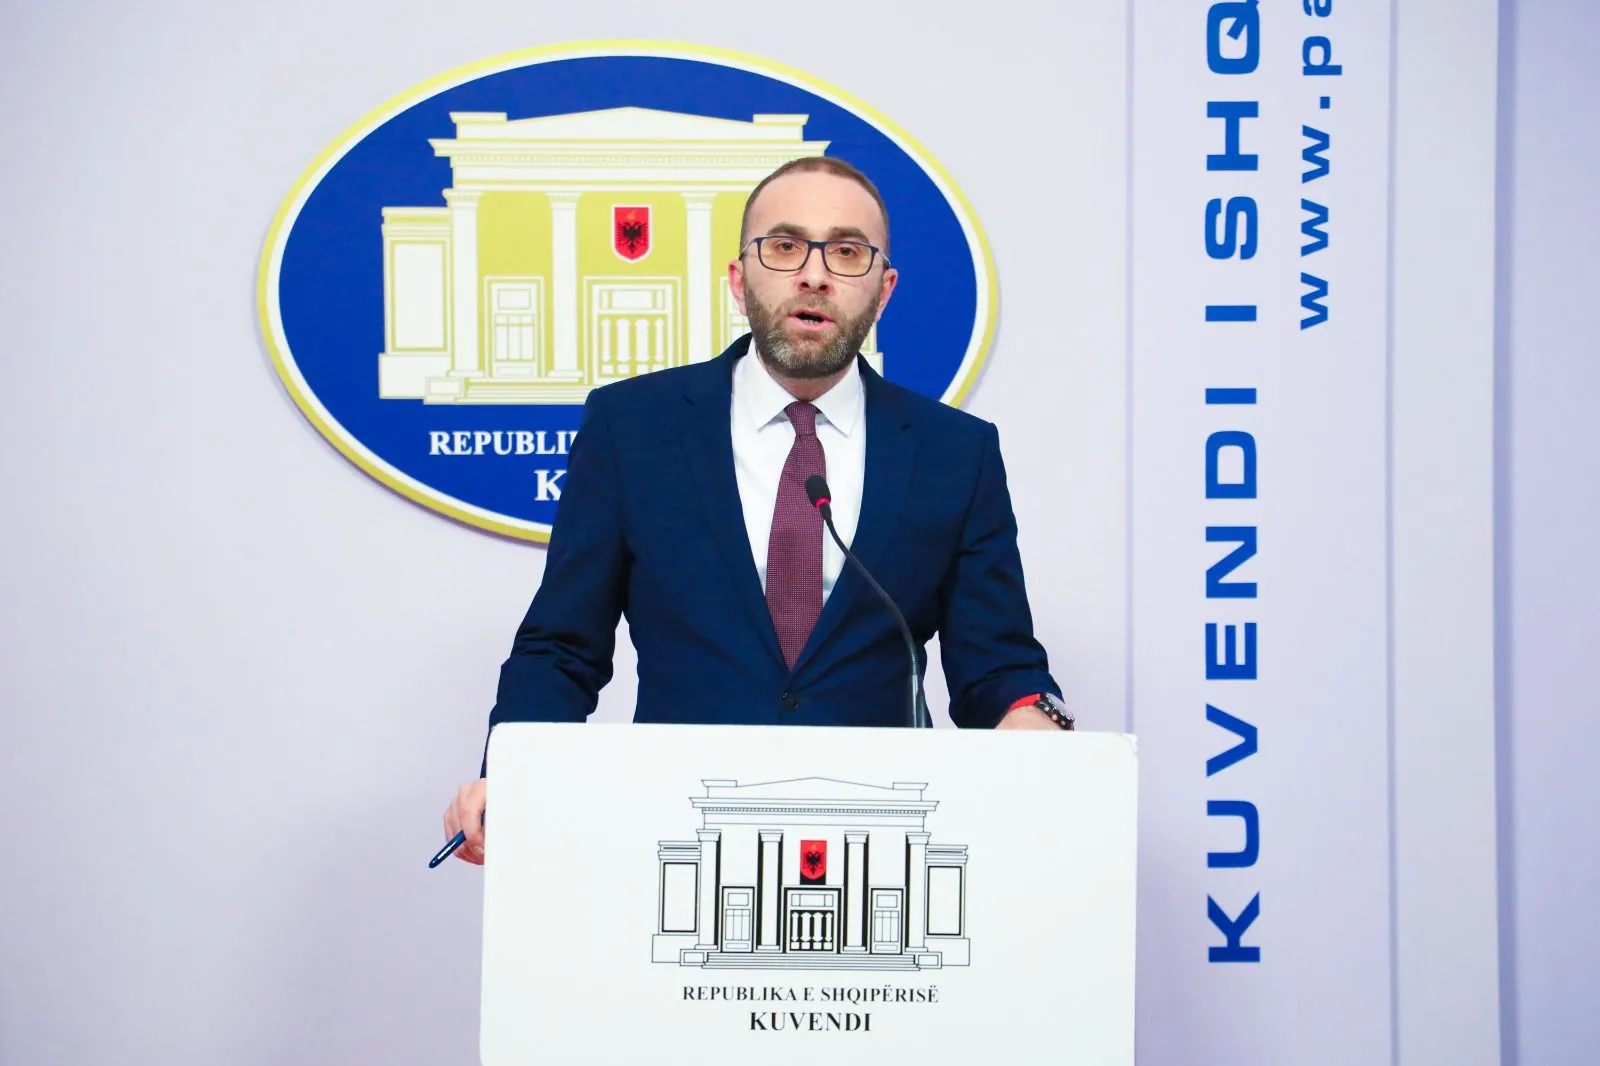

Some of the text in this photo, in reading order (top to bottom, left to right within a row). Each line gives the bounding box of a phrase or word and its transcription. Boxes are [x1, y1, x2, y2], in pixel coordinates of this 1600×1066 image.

[1204, 0, 1260, 963] KUVENDI I SHQ
[683, 984, 939, 1004] REPUBLIKA E SHQIPËRISË
[750, 1011, 872, 1032] KUVENDI
